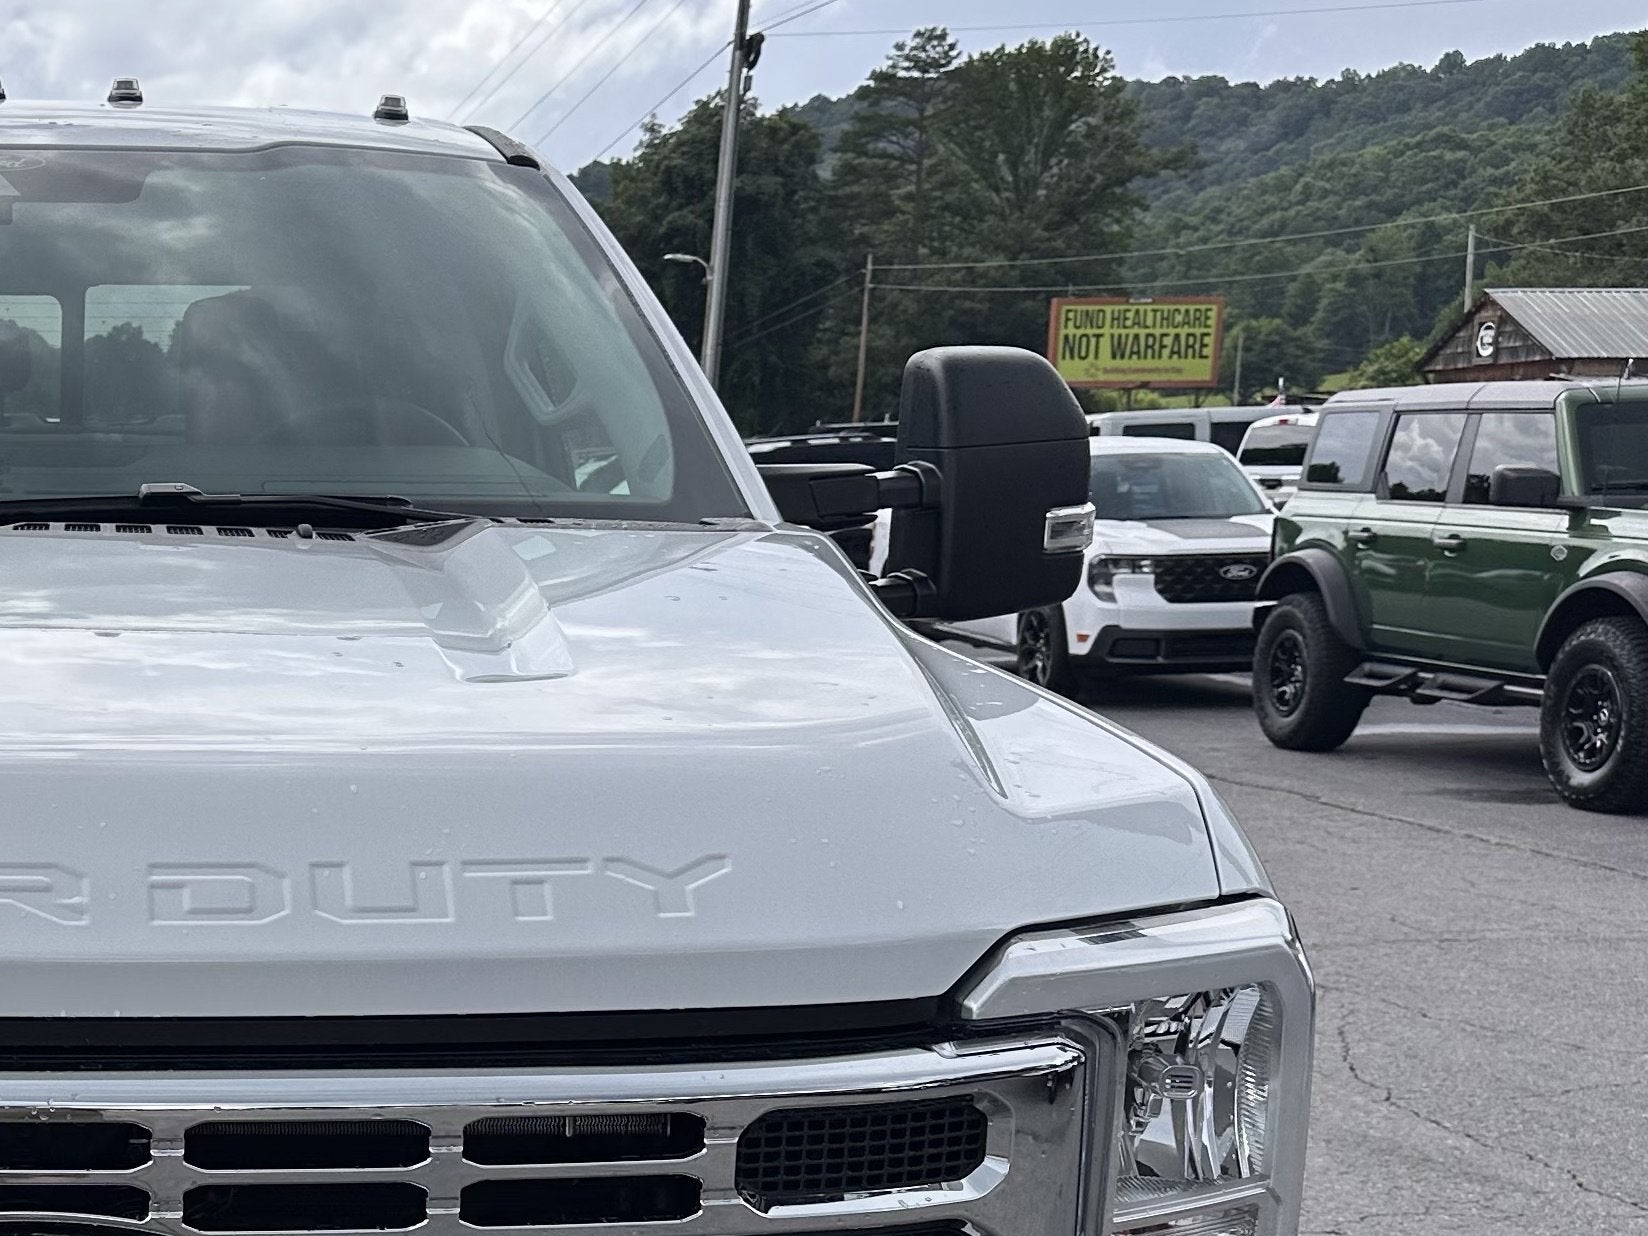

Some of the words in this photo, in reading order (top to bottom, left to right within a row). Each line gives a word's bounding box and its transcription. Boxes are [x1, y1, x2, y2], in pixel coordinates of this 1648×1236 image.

[1063, 308, 1106, 330] FUND
[1110, 307, 1213, 330] HEALTHCARE
[1061, 333, 1104, 361] NOT
[1109, 332, 1212, 360] WARFARE
[147, 853, 733, 926] DUTY
